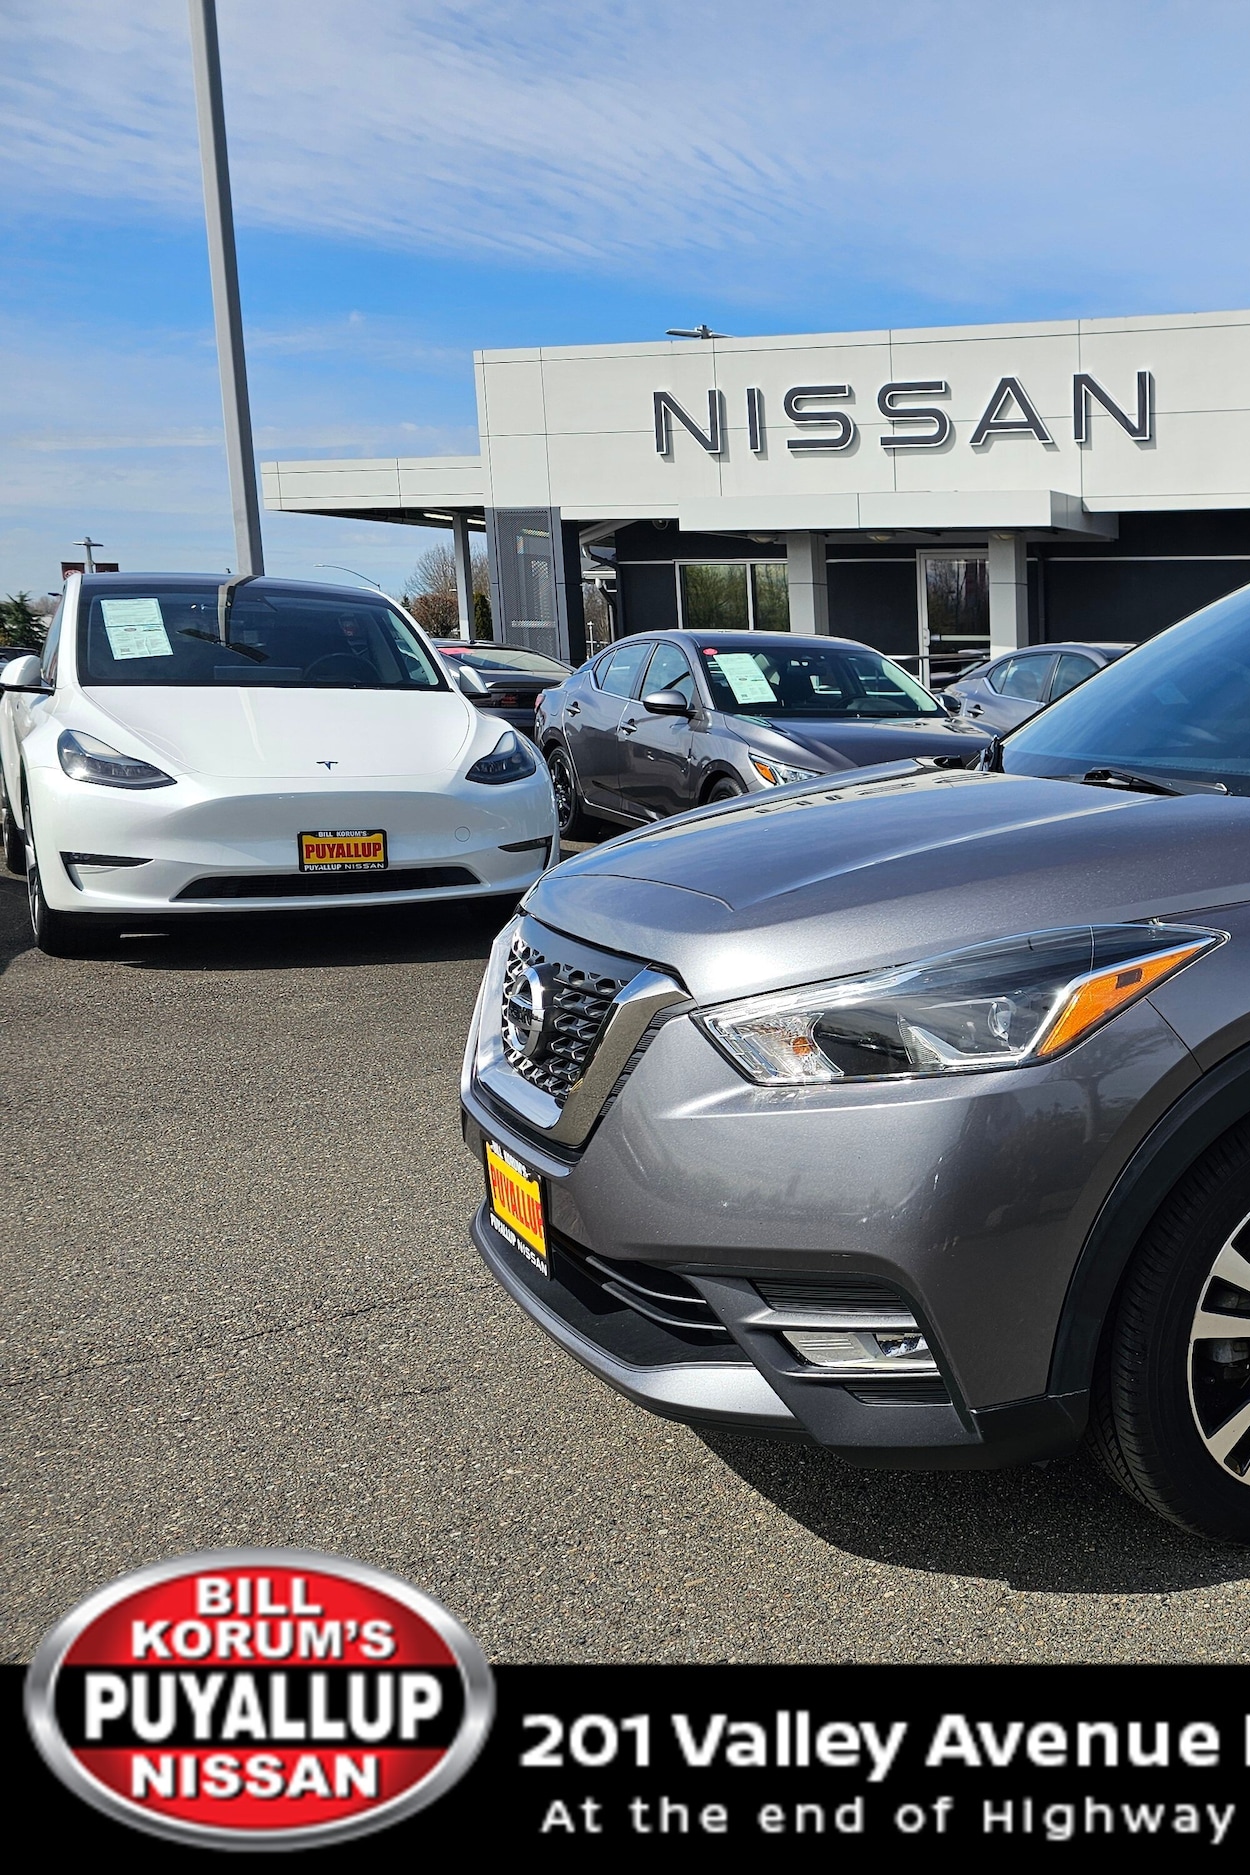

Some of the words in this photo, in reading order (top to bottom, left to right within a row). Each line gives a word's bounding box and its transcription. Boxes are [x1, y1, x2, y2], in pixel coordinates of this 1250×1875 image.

[652, 370, 1152, 456] NISSAN
[304, 842, 382, 859] PUYALLUP
[344, 862, 384, 870] NISSAN
[490, 1162, 544, 1240] PUYALLUP
[516, 1238, 548, 1277] NISSAN
